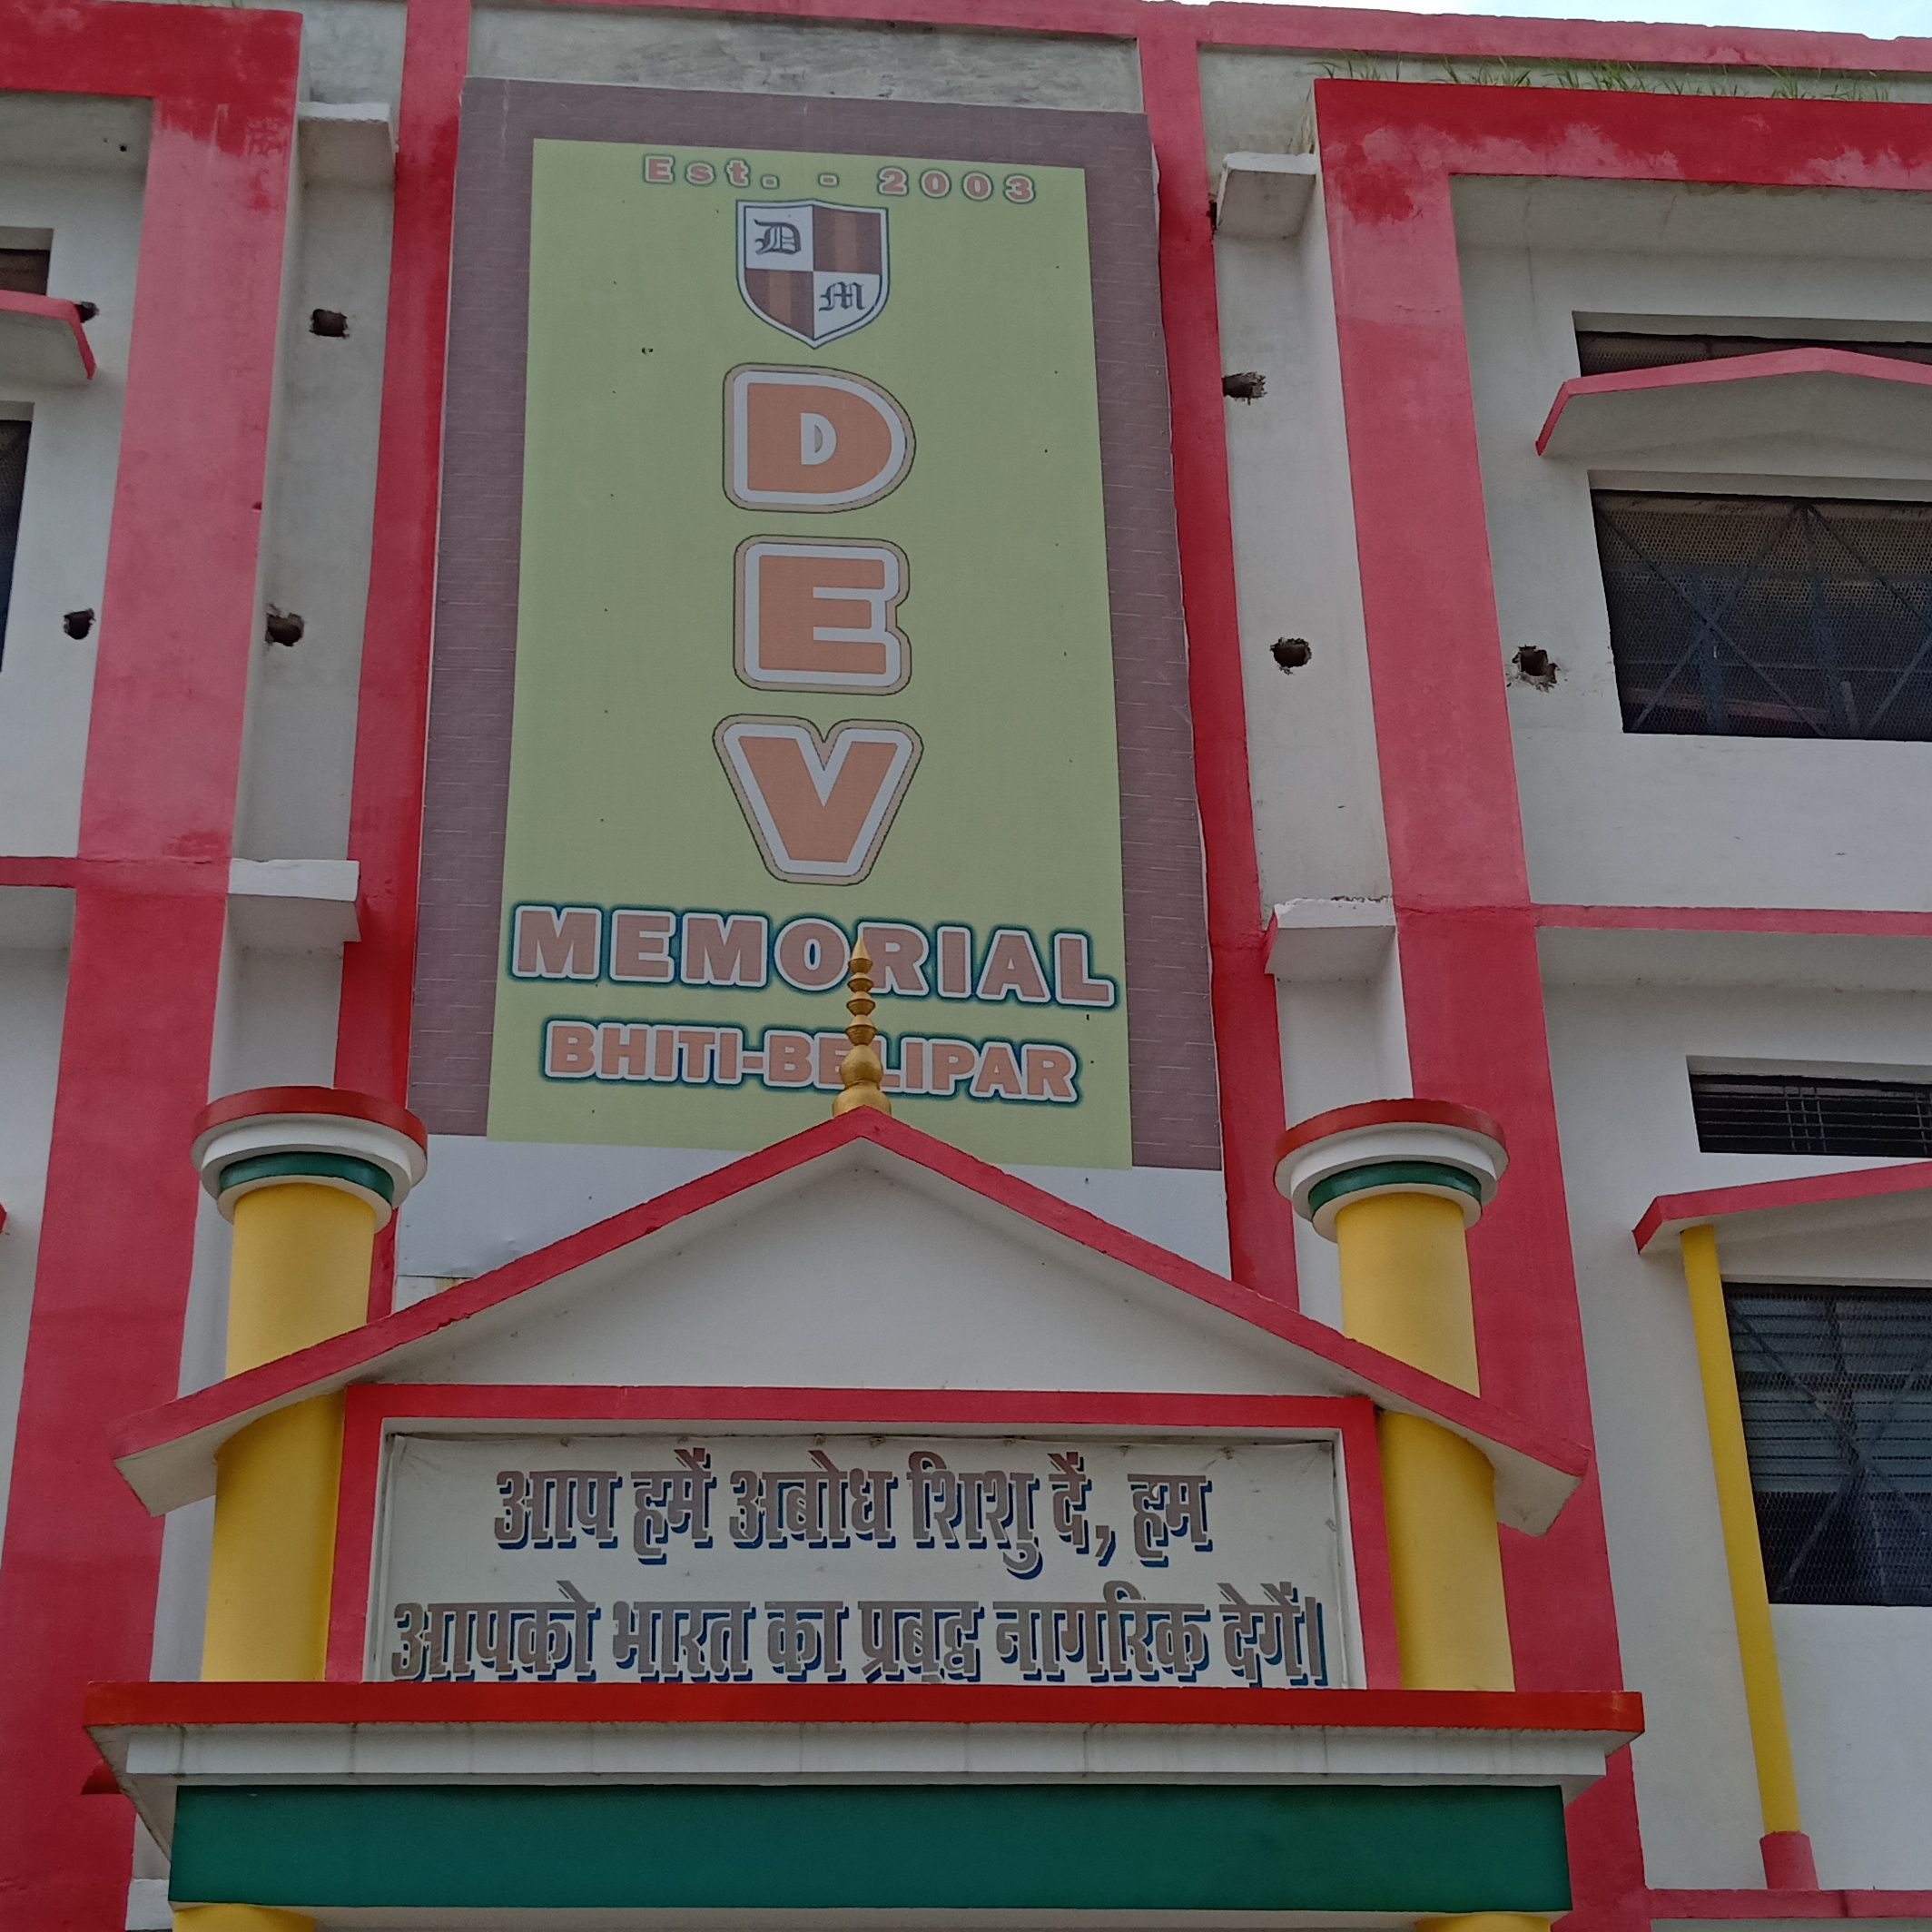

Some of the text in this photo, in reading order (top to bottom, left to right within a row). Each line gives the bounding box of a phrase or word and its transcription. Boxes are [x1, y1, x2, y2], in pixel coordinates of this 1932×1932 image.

[643, 153, 780, 189] Est.
[876, 165, 1036, 203] 2003
[510, 904, 1117, 1008] MEMORIAL
[494, 1447, 1213, 1580] आप हमें अबोध शिशु दें, हम
[390, 1580, 602, 1682] आपको
[611, 1600, 757, 1682] भारत
[764, 1600, 850, 1682] का
[857, 1600, 986, 1685] प्रबद्ध
[992, 1580, 1211, 1683] नागरिक
